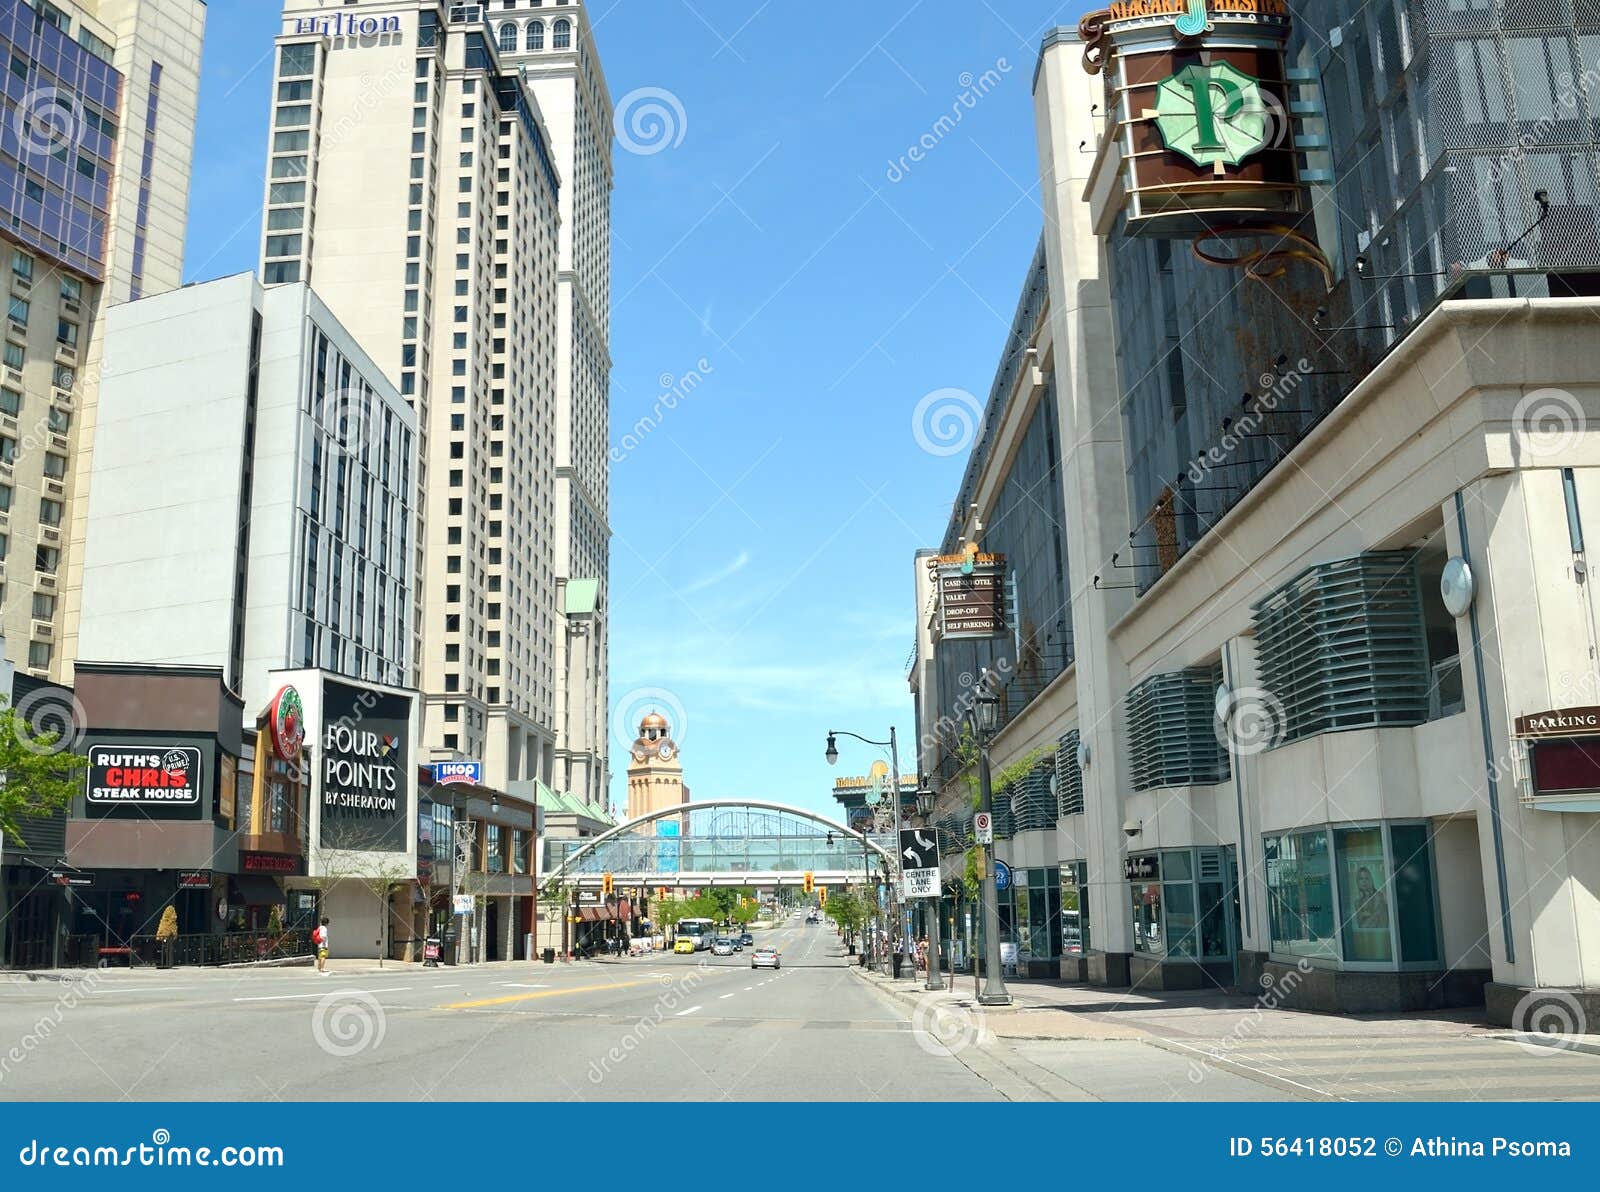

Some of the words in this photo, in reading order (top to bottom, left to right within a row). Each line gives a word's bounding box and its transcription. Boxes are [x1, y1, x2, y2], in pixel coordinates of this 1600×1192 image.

[296, 12, 400, 37] Hilton
[1114, 15, 1172, 30] CASIN
[945, 593, 967, 601] VALET
[946, 607, 979, 616] DROP-OFF
[947, 622, 961, 630] SELF
[963, 620, 990, 629] PARKING
[1529, 714, 1597, 729] PARKING
[326, 724, 380, 758] FOUR
[97, 753, 160, 768] RUTH'S
[106, 767, 187, 787] CHRIS
[326, 758, 396, 791] POINTS
[442, 764, 475, 777] IHOP
[93, 788, 140, 798] STEAK
[145, 788, 192, 799] HOUSE
[325, 791, 338, 805] BY
[340, 792, 396, 811] SHERATON
[905, 870, 937, 879] CENTRE
[910, 878, 932, 886] LANE
[911, 886, 931, 894] ONLY
